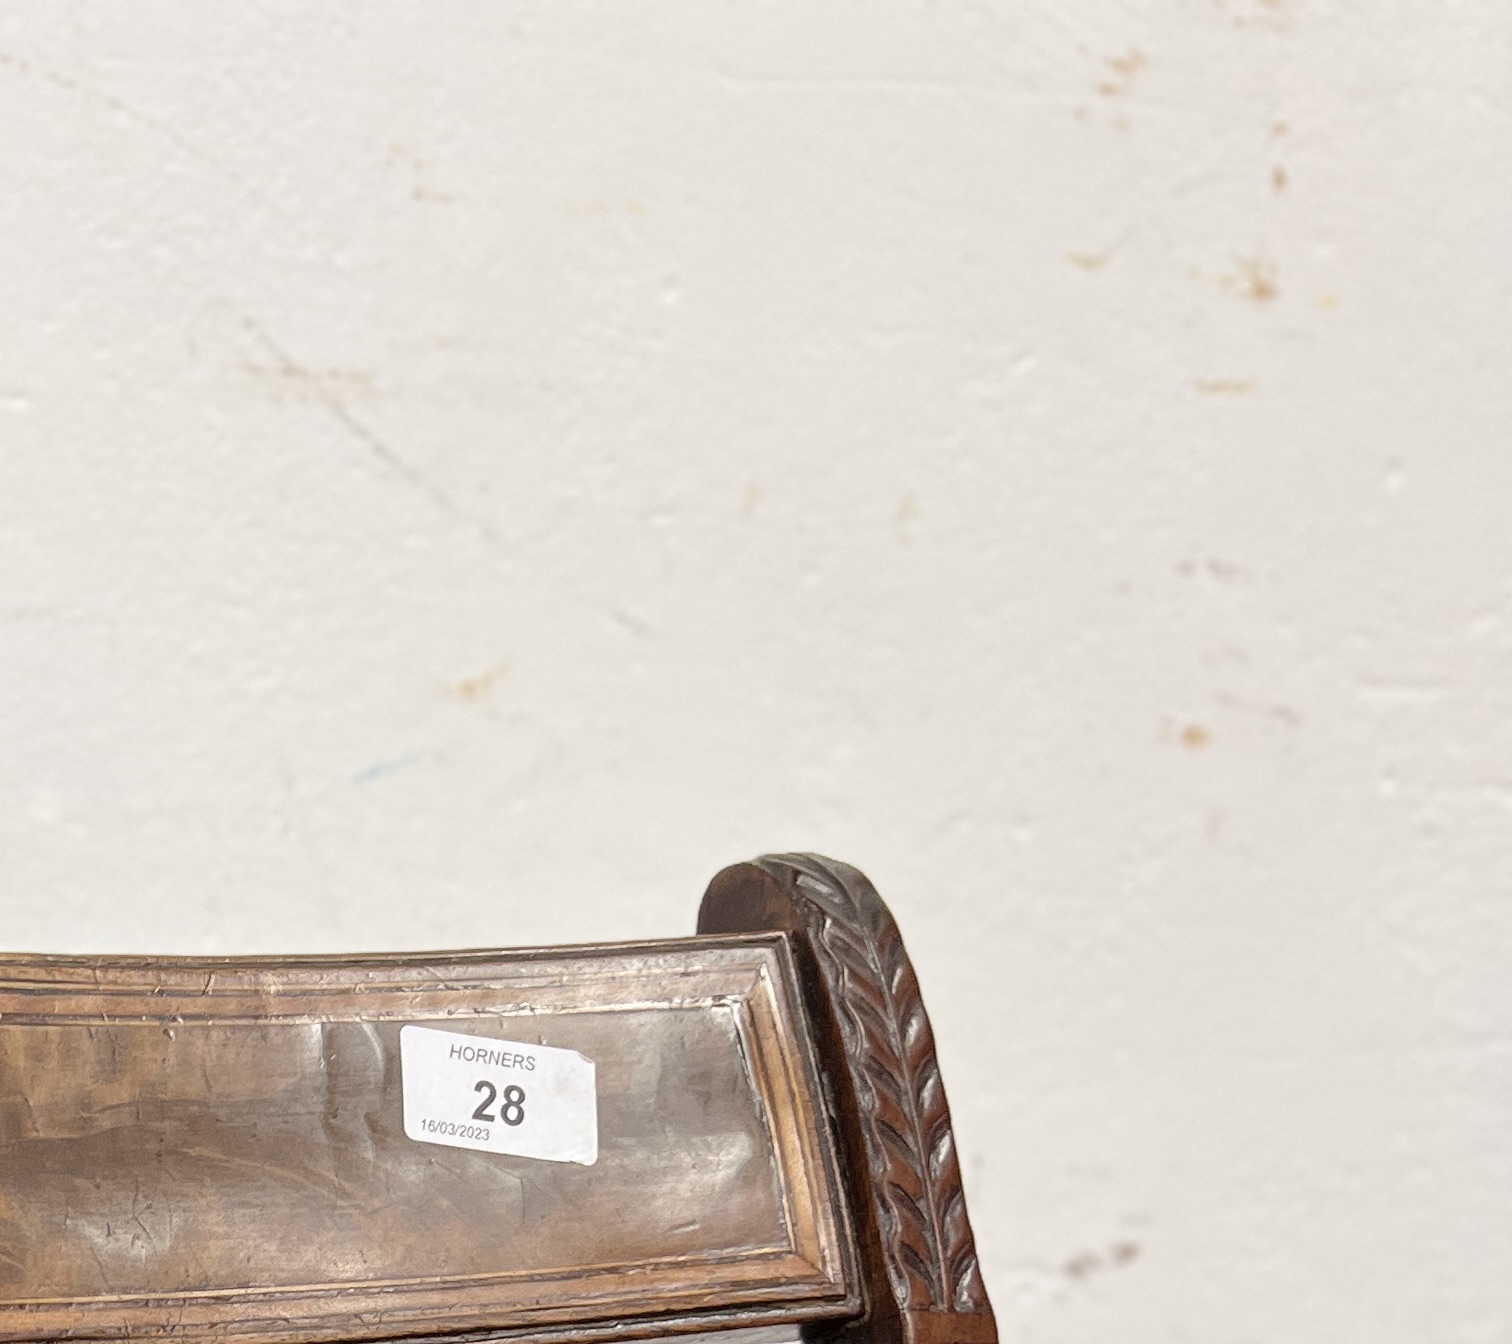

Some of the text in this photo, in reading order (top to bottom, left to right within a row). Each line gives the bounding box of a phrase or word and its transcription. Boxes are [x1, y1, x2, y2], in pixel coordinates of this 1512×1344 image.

[449, 1043, 536, 1071] HORNERS
[471, 1080, 526, 1127] 28
[420, 1118, 490, 1141] 16/03/2023
